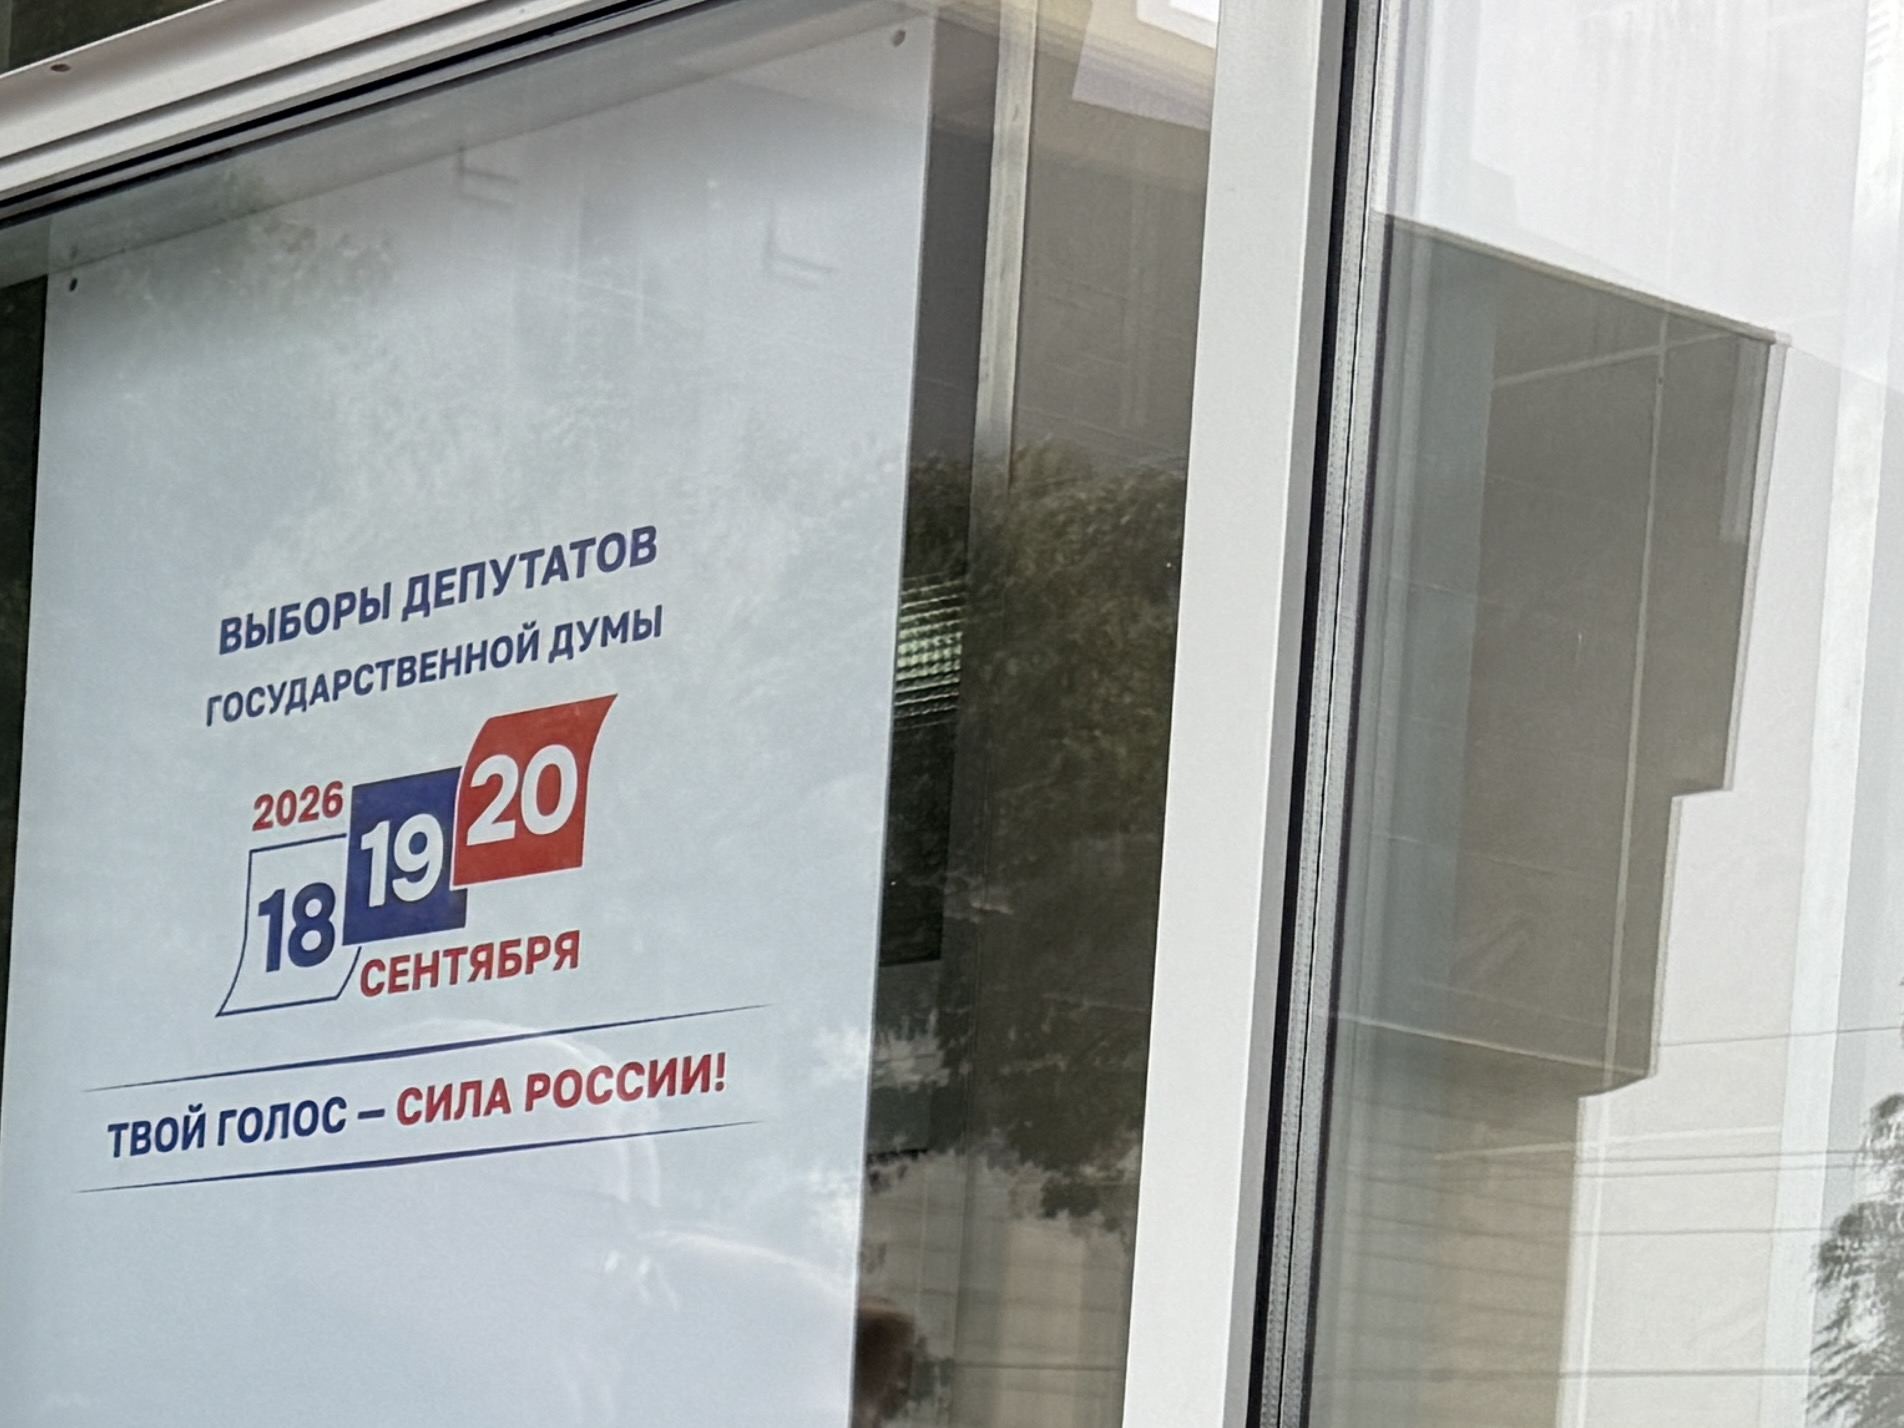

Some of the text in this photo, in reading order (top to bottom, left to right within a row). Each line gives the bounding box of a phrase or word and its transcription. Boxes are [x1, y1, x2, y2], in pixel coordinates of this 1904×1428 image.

[218, 525, 659, 656] ВЫБОРЫ ДЕПУТАТОВ
[205, 603, 664, 728] ГОСУДАРСТВЕННОЙ ДУМЫ
[251, 780, 345, 833] 2026
[257, 743, 580, 973] 18 19 20
[358, 928, 582, 998] СЕНТЯБРЯ
[106, 1103, 207, 1160] ТВОЙ
[216, 1095, 348, 1147] ГОЛОС
[395, 1077, 512, 1127] СИЛА
[524, 1051, 728, 1113] РОССИИ!
